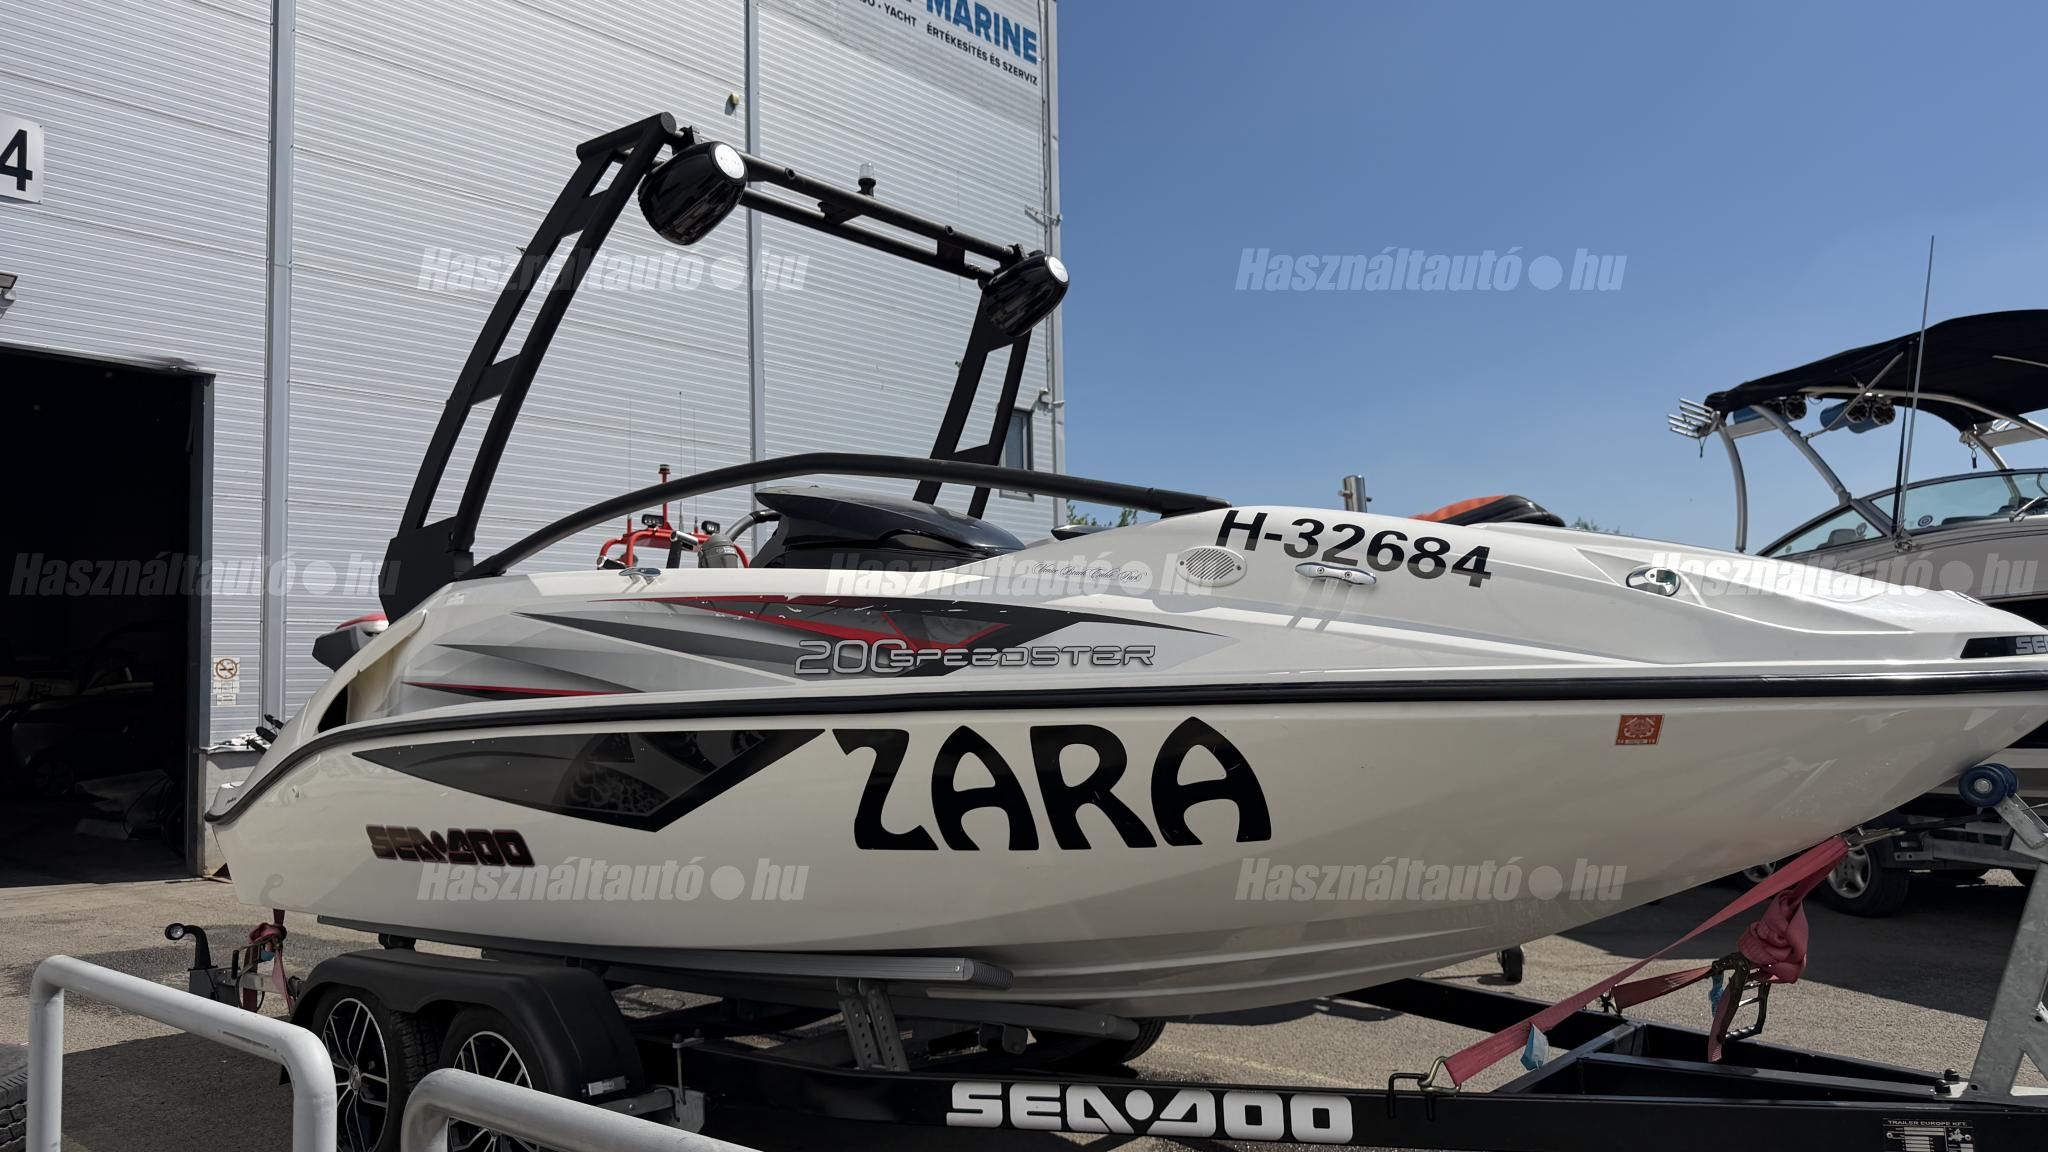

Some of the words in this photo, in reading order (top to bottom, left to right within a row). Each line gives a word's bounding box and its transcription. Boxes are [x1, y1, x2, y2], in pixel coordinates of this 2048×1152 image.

[884, 3, 917, 27] YACHT
[926, 22, 988, 62] ÉRTÉKESÍTÉS
[989, 52, 1001, 68] ÉS
[1002, 61, 1038, 86] SZERVIZ
[926, 0, 1037, 65] MARINE
[0, 128, 33, 192] 4
[1215, 510, 1492, 588] H-32684
[794, 639, 907, 675] 200
[889, 645, 1156, 668] SPEEDSTER
[2015, 633, 2048, 655] SE
[832, 716, 1272, 851] ZARA
